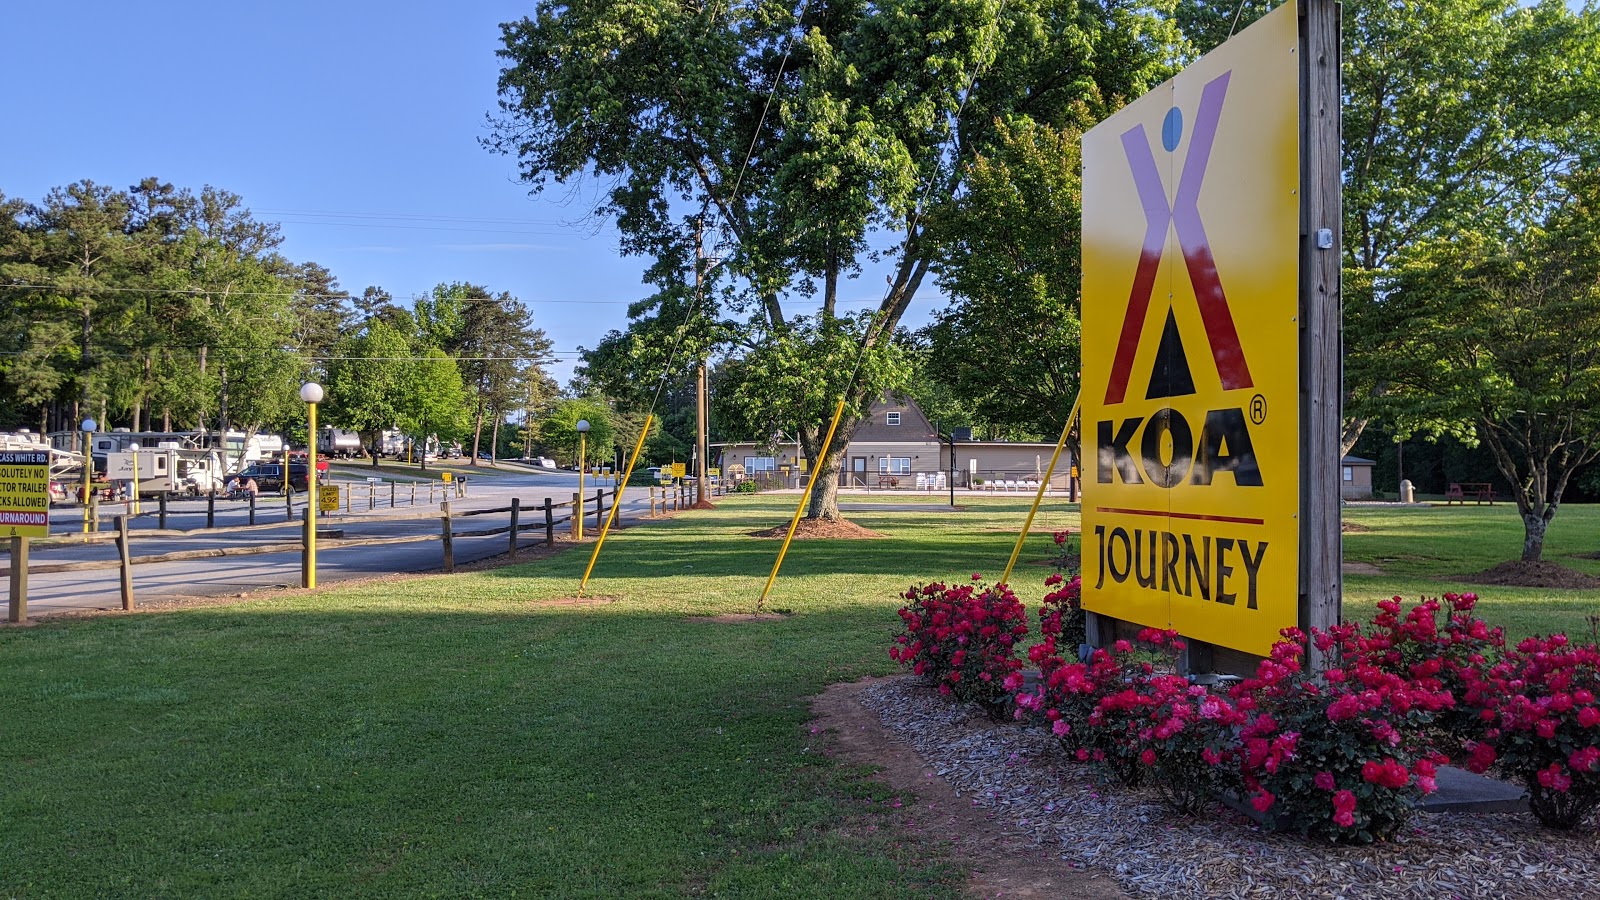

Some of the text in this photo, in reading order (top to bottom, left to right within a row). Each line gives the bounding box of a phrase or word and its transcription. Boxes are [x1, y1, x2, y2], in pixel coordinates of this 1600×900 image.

[1097, 407, 1264, 489] KOA
[15, 453, 35, 463] WHITE
[36, 454, 48, 463] RD.
[0, 468, 45, 478] OLUTELY NO
[18, 482, 47, 493] TRAILER
[12, 497, 47, 507] ALLOWED
[1094, 524, 1270, 611] JOURNEY
